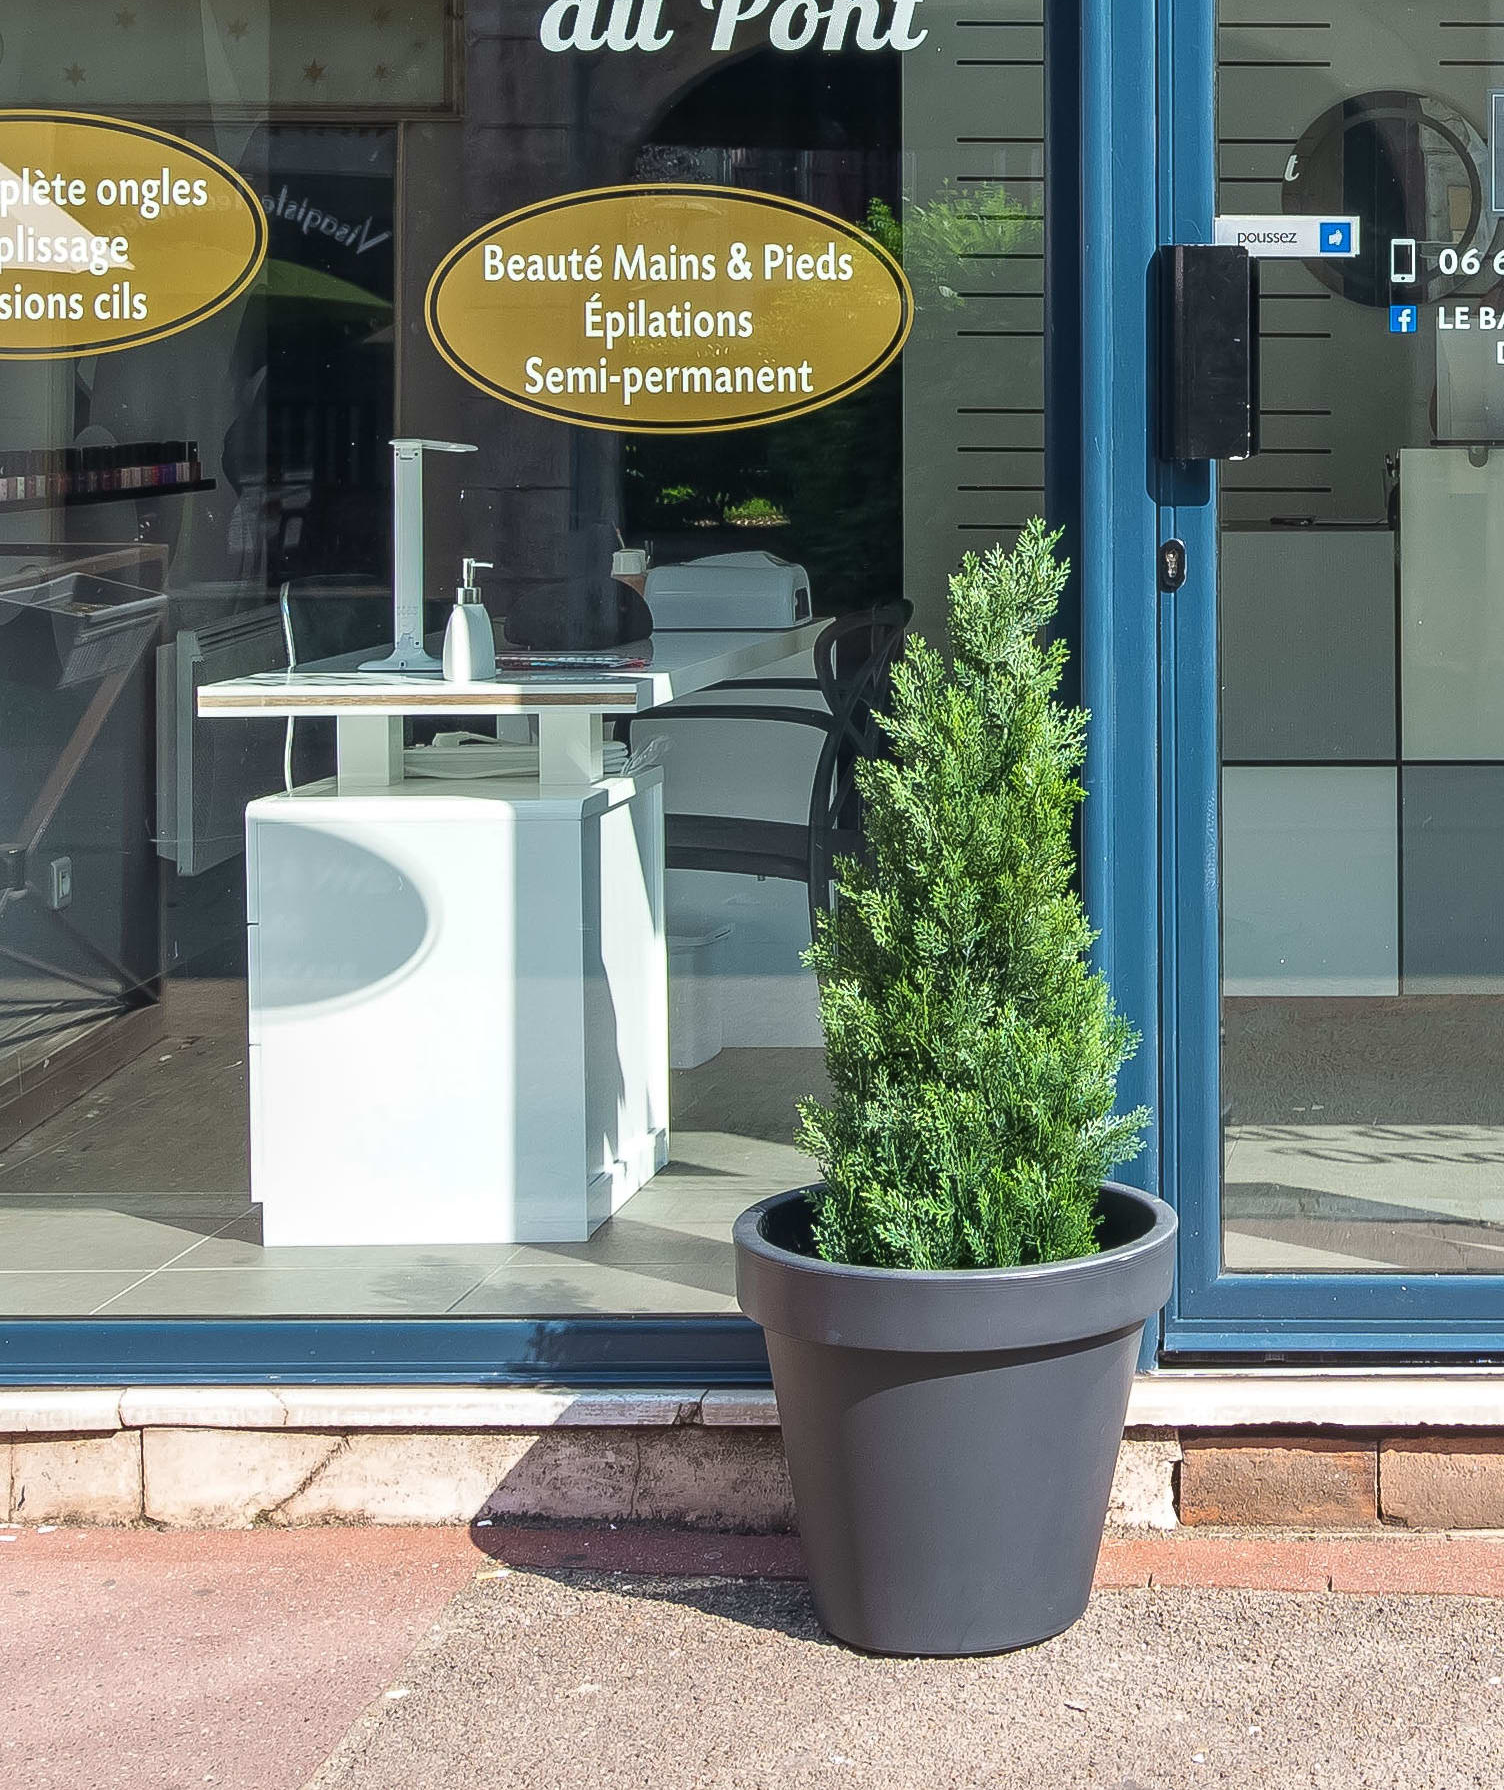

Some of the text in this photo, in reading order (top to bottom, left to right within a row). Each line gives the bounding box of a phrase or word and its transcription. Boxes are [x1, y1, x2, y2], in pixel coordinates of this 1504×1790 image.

[97, 168, 207, 219] ongles
[1237, 232, 1298, 247] poussez
[484, 242, 853, 281] Beauté Mains & Pieds
[1439, 248, 1480, 275] 06
[94, 281, 147, 320] cils
[585, 292, 753, 345] Épilations
[1438, 306, 1471, 330] LE
[525, 356, 814, 402] Semi-permanent
